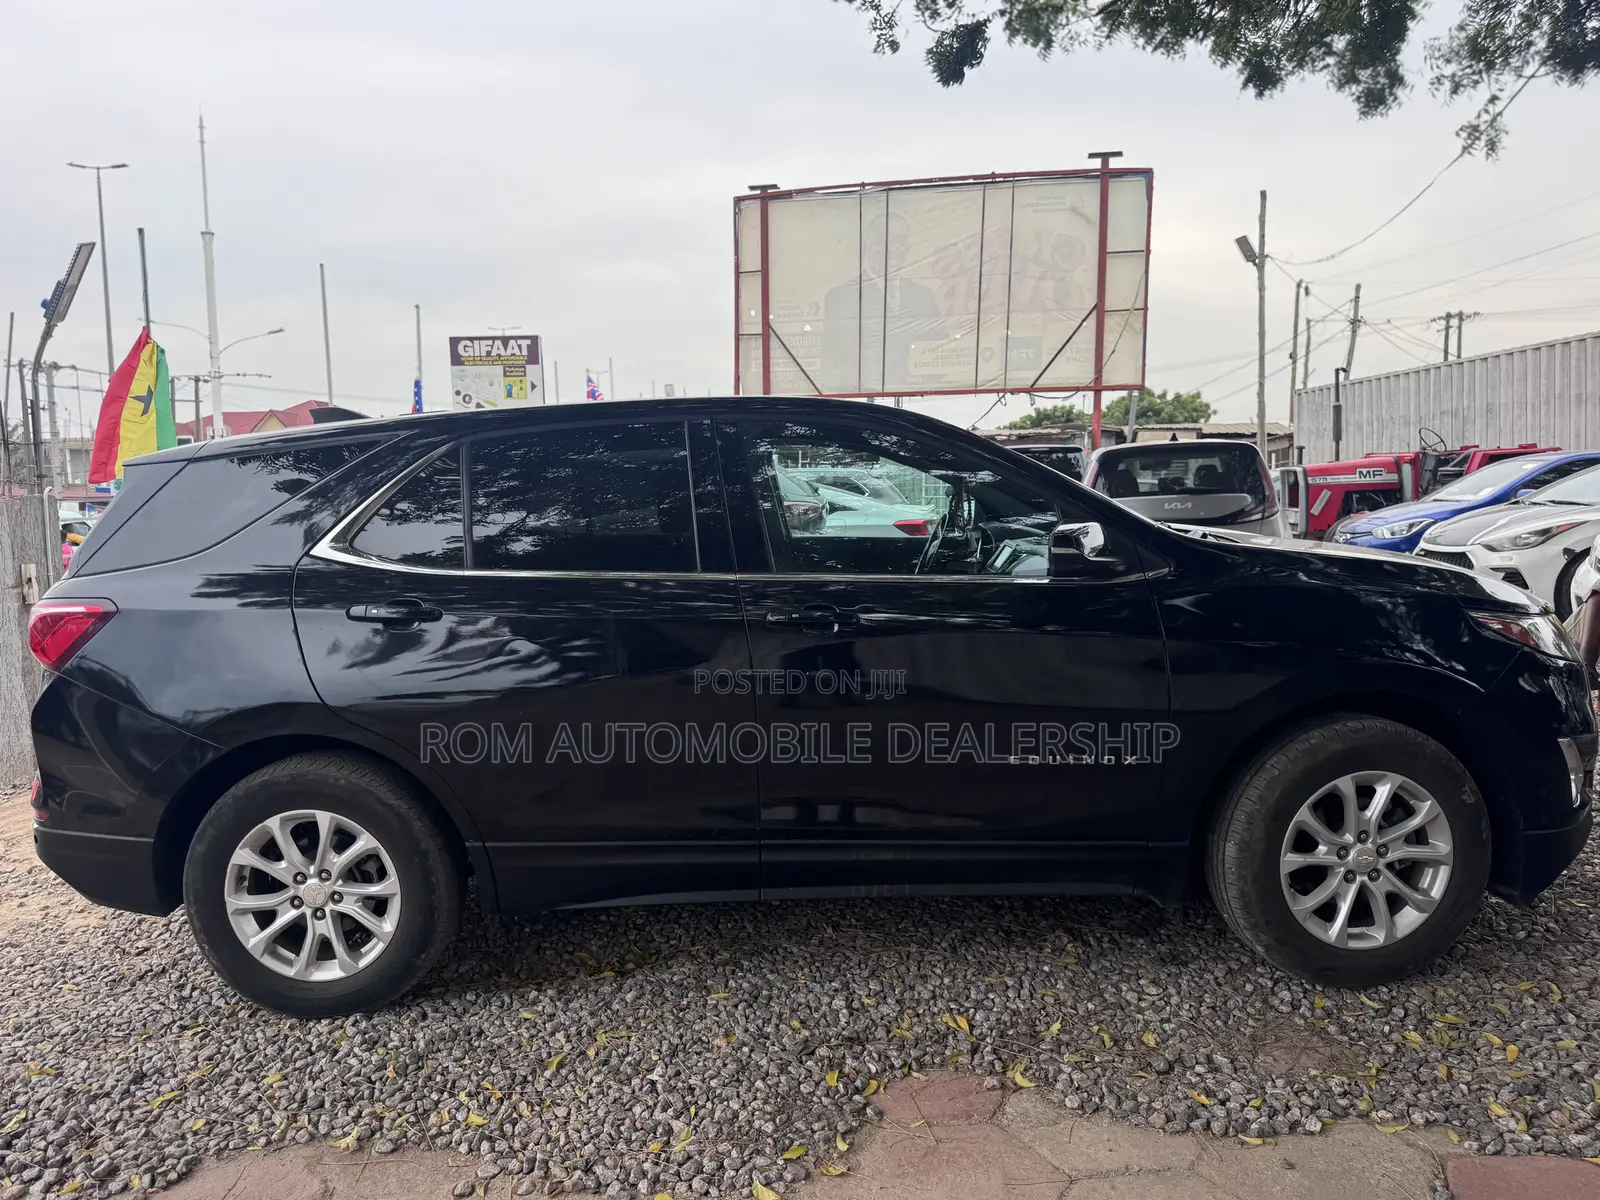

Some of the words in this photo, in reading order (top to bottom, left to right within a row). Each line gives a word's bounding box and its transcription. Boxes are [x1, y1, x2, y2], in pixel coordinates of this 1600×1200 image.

[457, 339, 531, 357] GIFAAT
[1357, 469, 1384, 480] MF
[1164, 501, 1193, 510] KIA
[1009, 755, 1138, 765] EQUINOX
